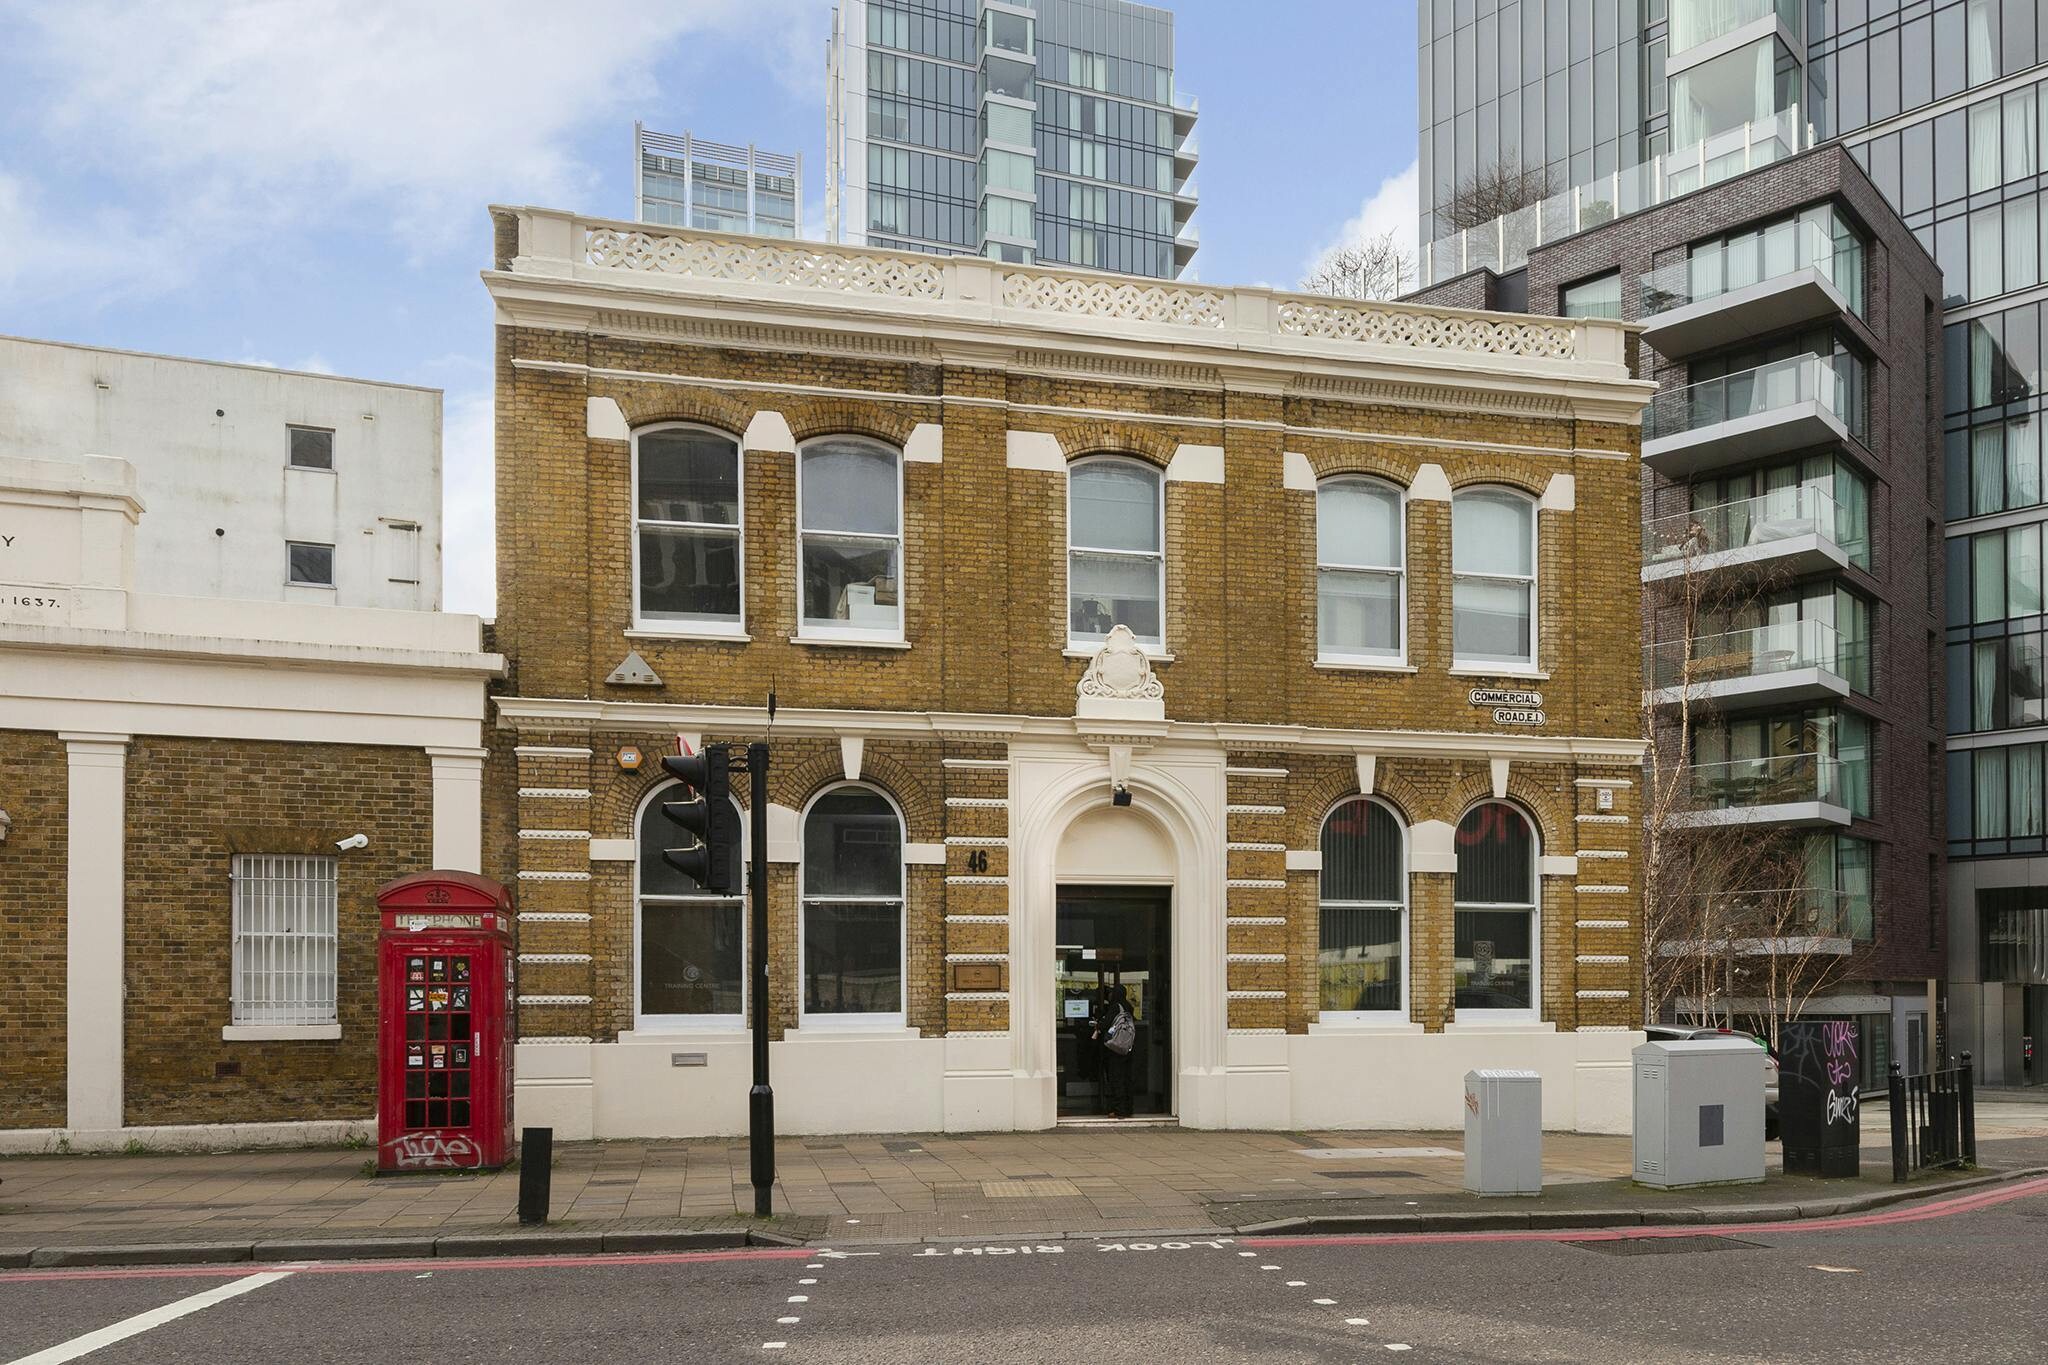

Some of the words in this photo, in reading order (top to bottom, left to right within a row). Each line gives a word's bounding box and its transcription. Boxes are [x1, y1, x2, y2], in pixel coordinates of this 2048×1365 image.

[13, 596, 60, 608] 1637.
[1474, 692, 1537, 704] COMMERCIAL
[968, 849, 987, 873] 46
[912, 1245, 1065, 1256] RIGHT
[1096, 1241, 1224, 1252] LOOK
